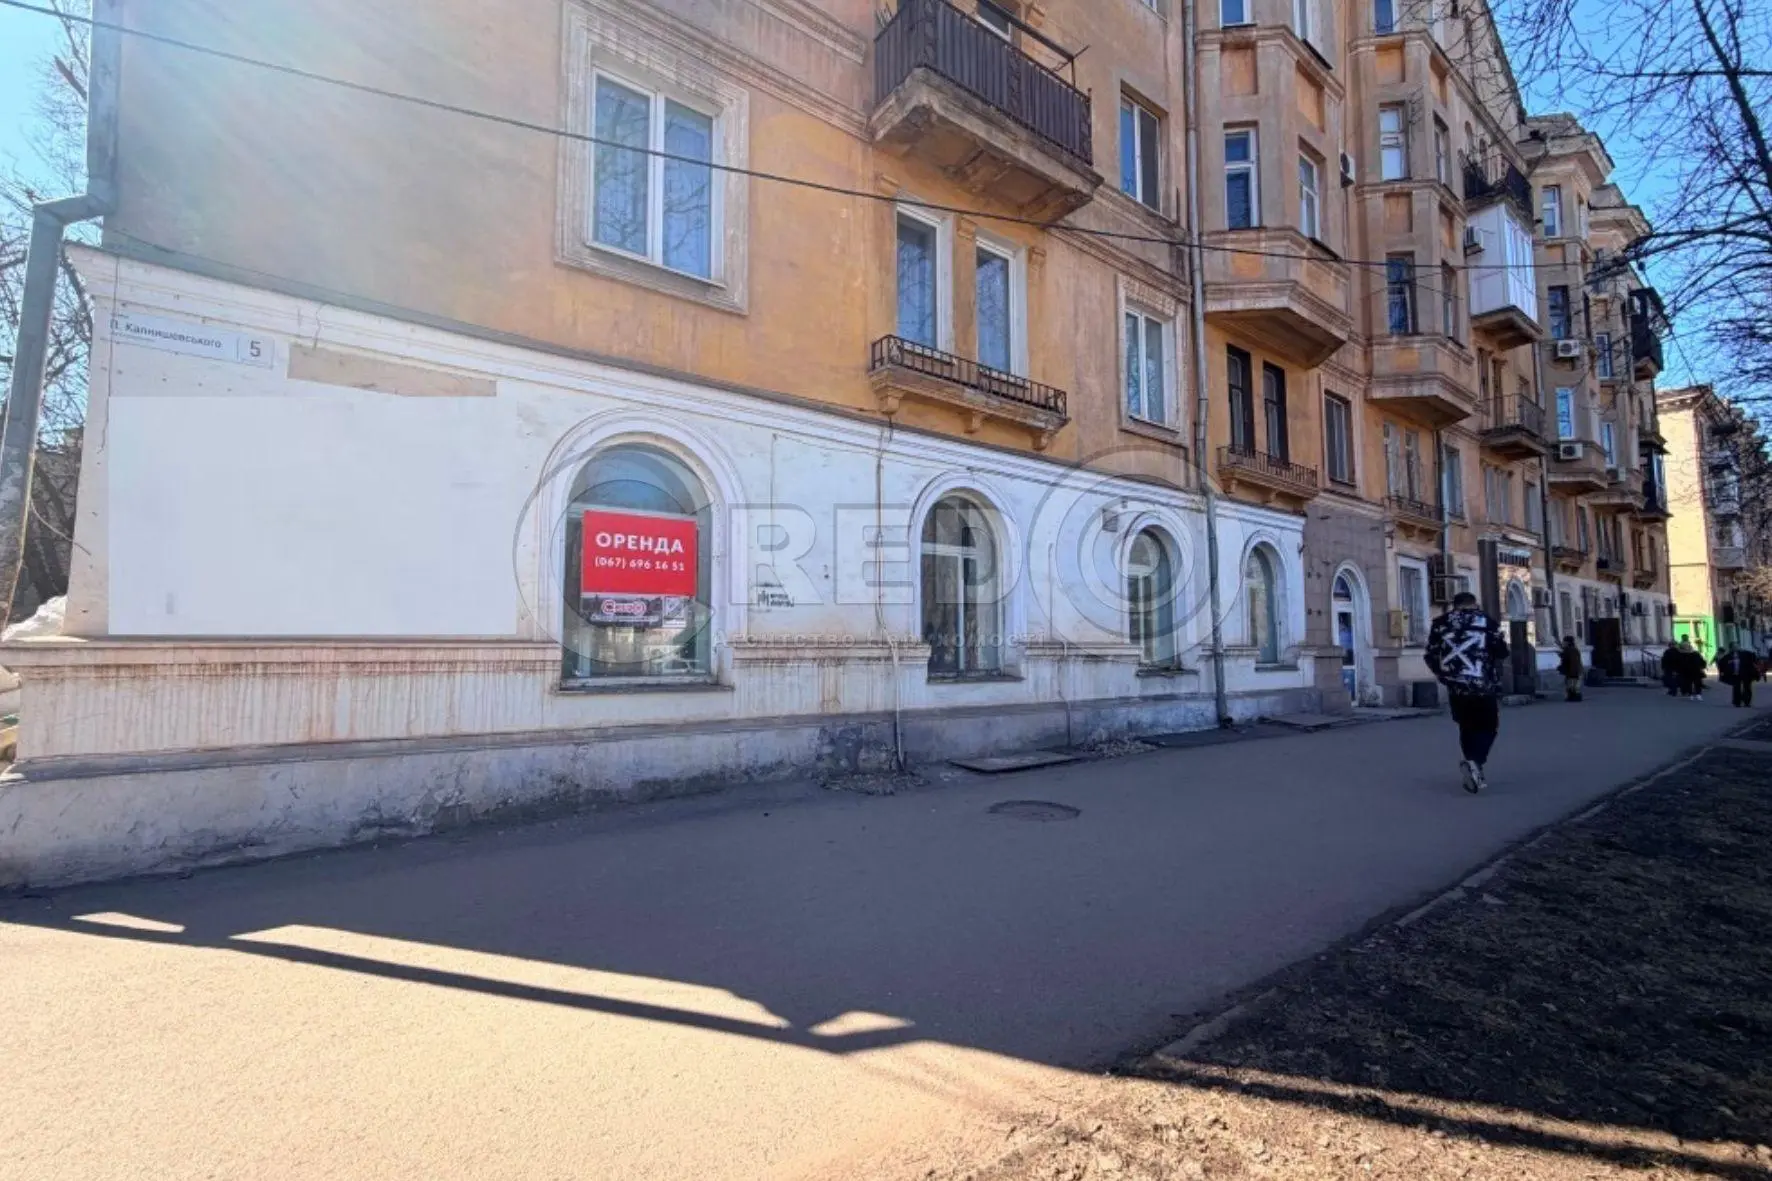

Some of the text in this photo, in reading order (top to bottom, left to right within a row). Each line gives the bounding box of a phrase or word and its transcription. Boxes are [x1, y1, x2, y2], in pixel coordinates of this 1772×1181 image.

[249, 340, 262, 357] 5
[595, 532, 684, 555] ОРЕНДА
[595, 557, 684, 571] (067) 696 16 51
